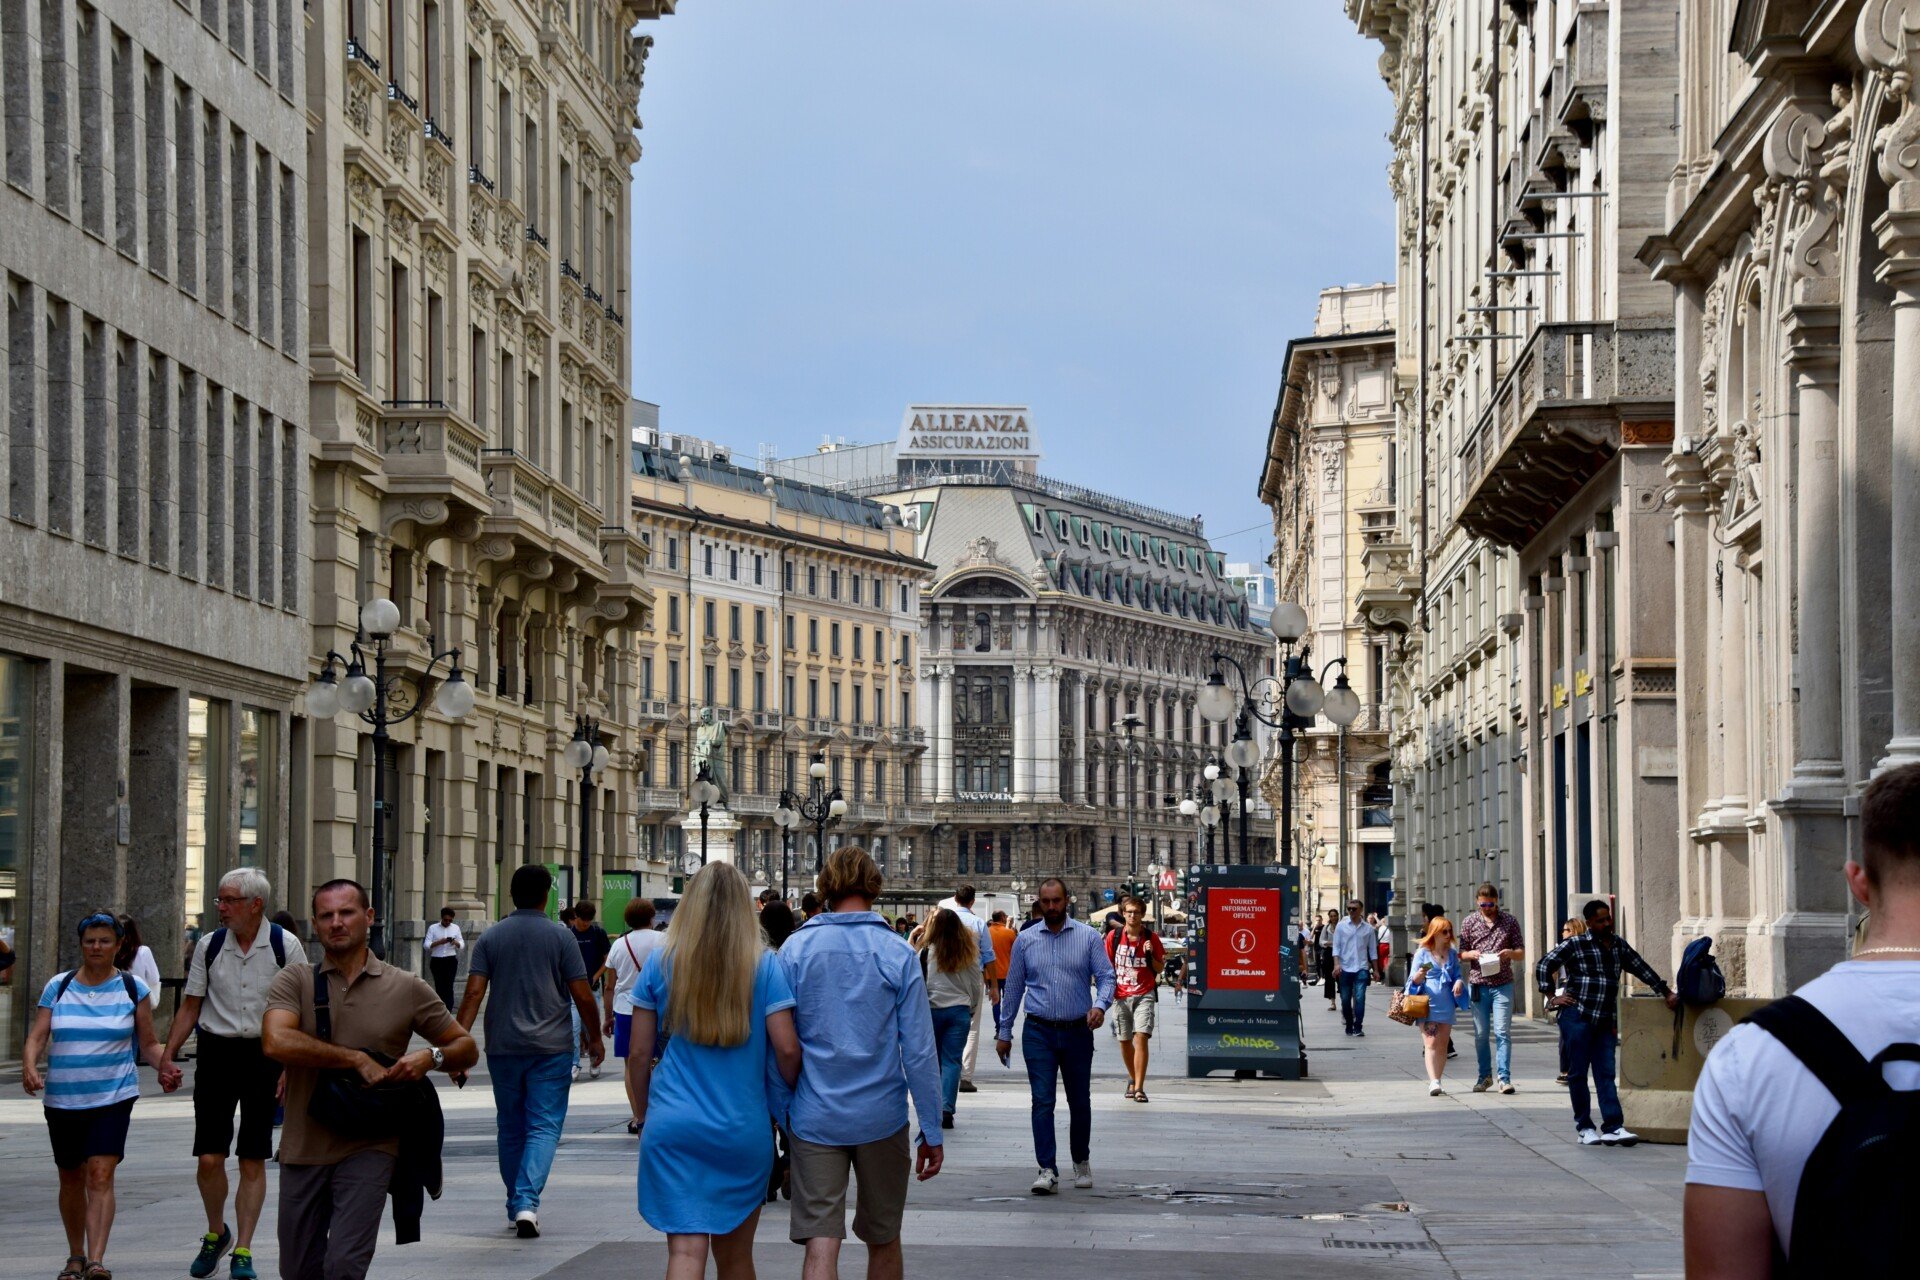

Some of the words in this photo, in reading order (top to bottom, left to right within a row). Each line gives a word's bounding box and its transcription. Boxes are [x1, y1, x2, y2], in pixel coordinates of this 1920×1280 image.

[909, 414, 1029, 432] ALLEANZA
[909, 436, 1029, 449] ASSICURAZIONI
[959, 787, 1013, 800] wework
[1159, 875, 1174, 886] M
